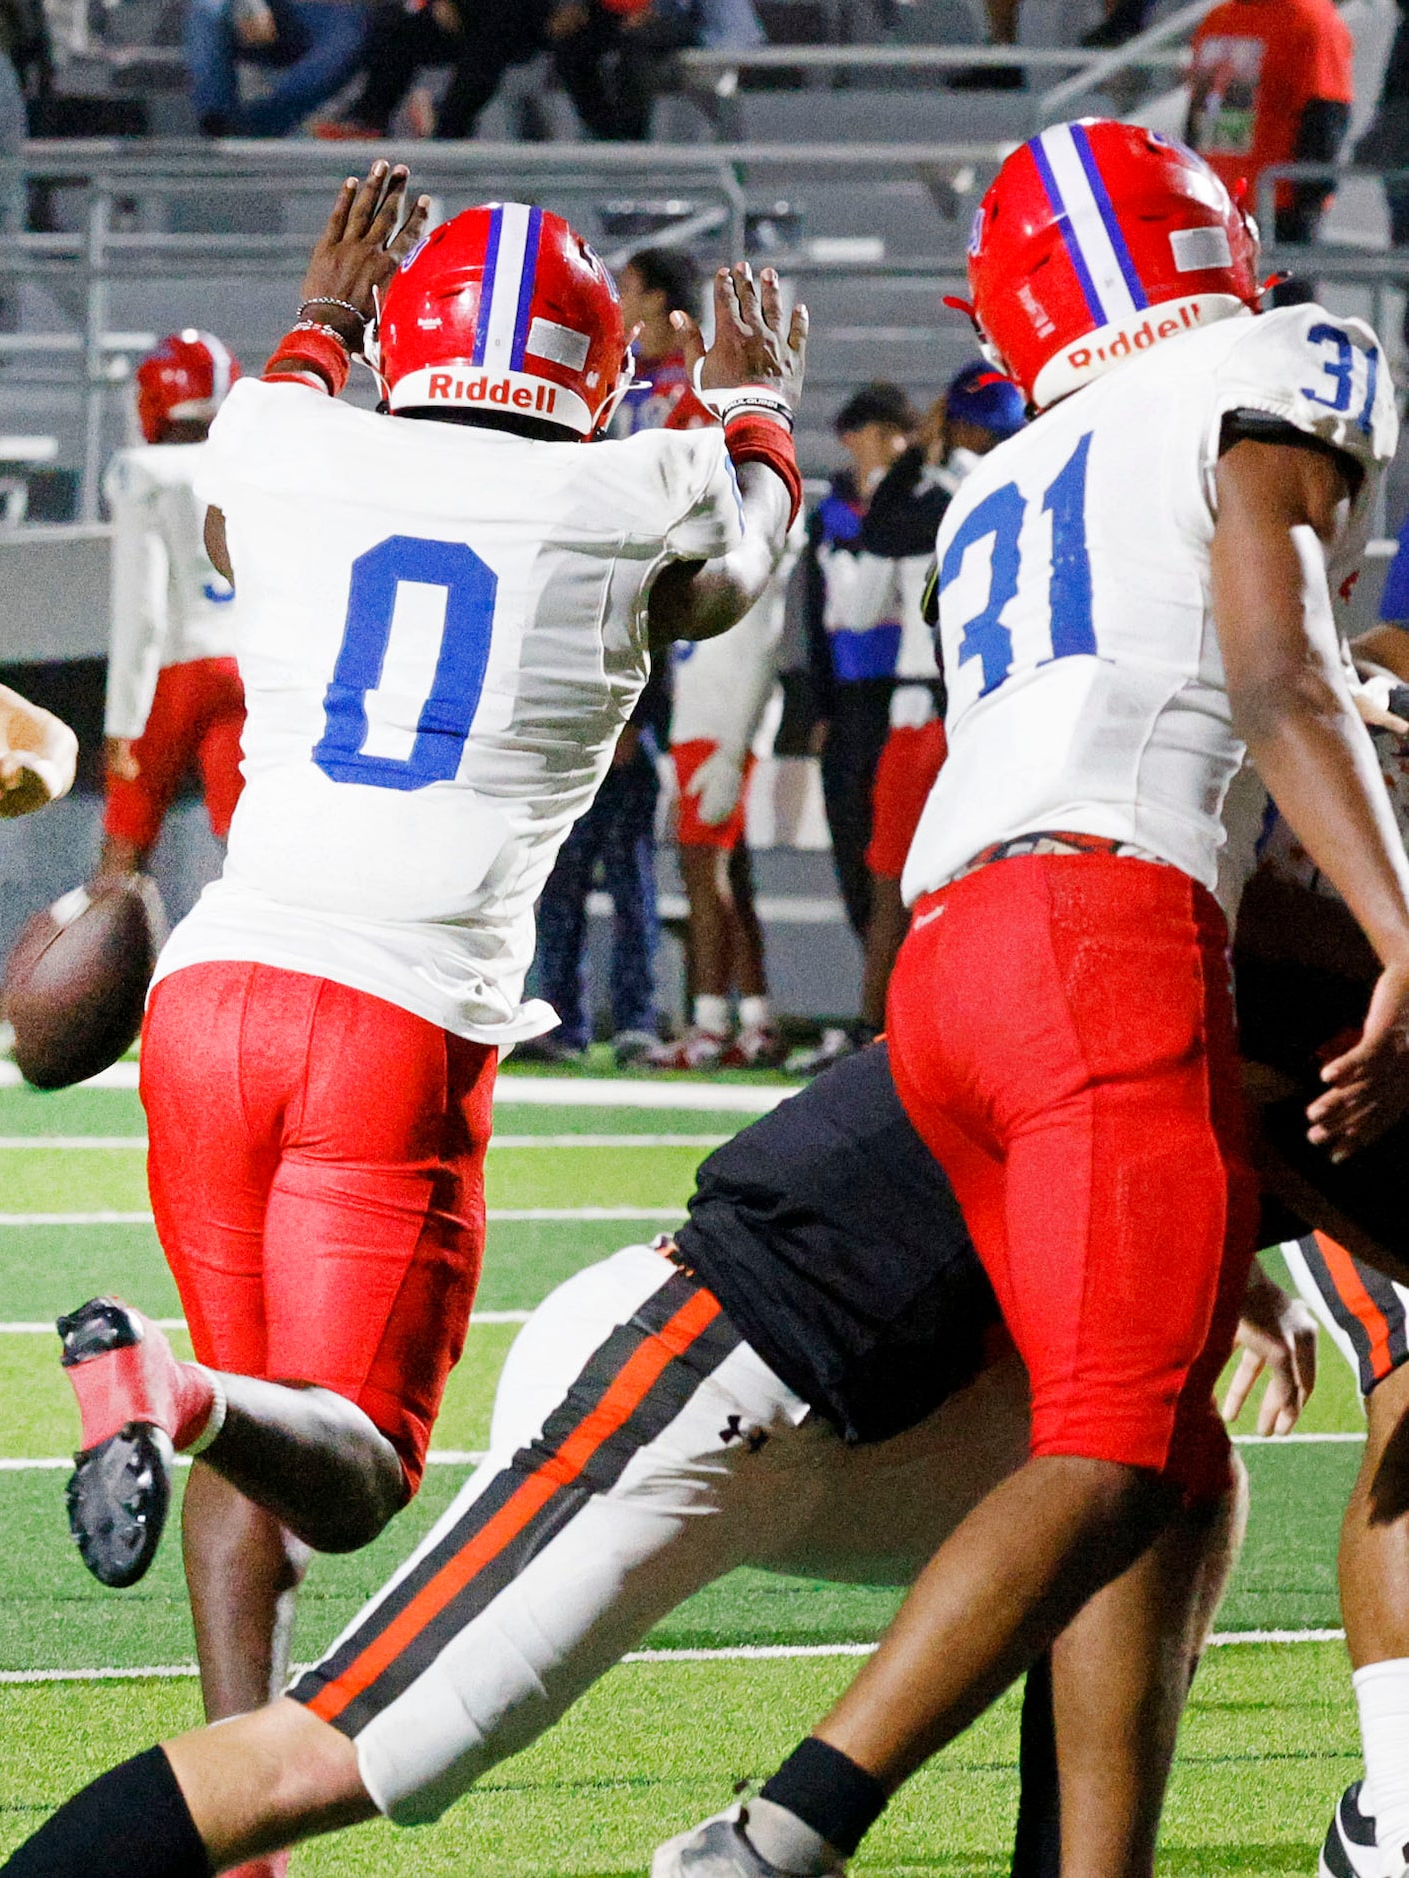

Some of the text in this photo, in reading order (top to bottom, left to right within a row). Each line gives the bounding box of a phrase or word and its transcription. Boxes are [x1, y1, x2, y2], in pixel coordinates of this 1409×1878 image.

[1067, 303, 1201, 369] Riddell
[1301, 323, 1379, 437] 31
[428, 373, 557, 414] Riddell
[938, 429, 1117, 699] 31
[311, 534, 498, 791] 0
